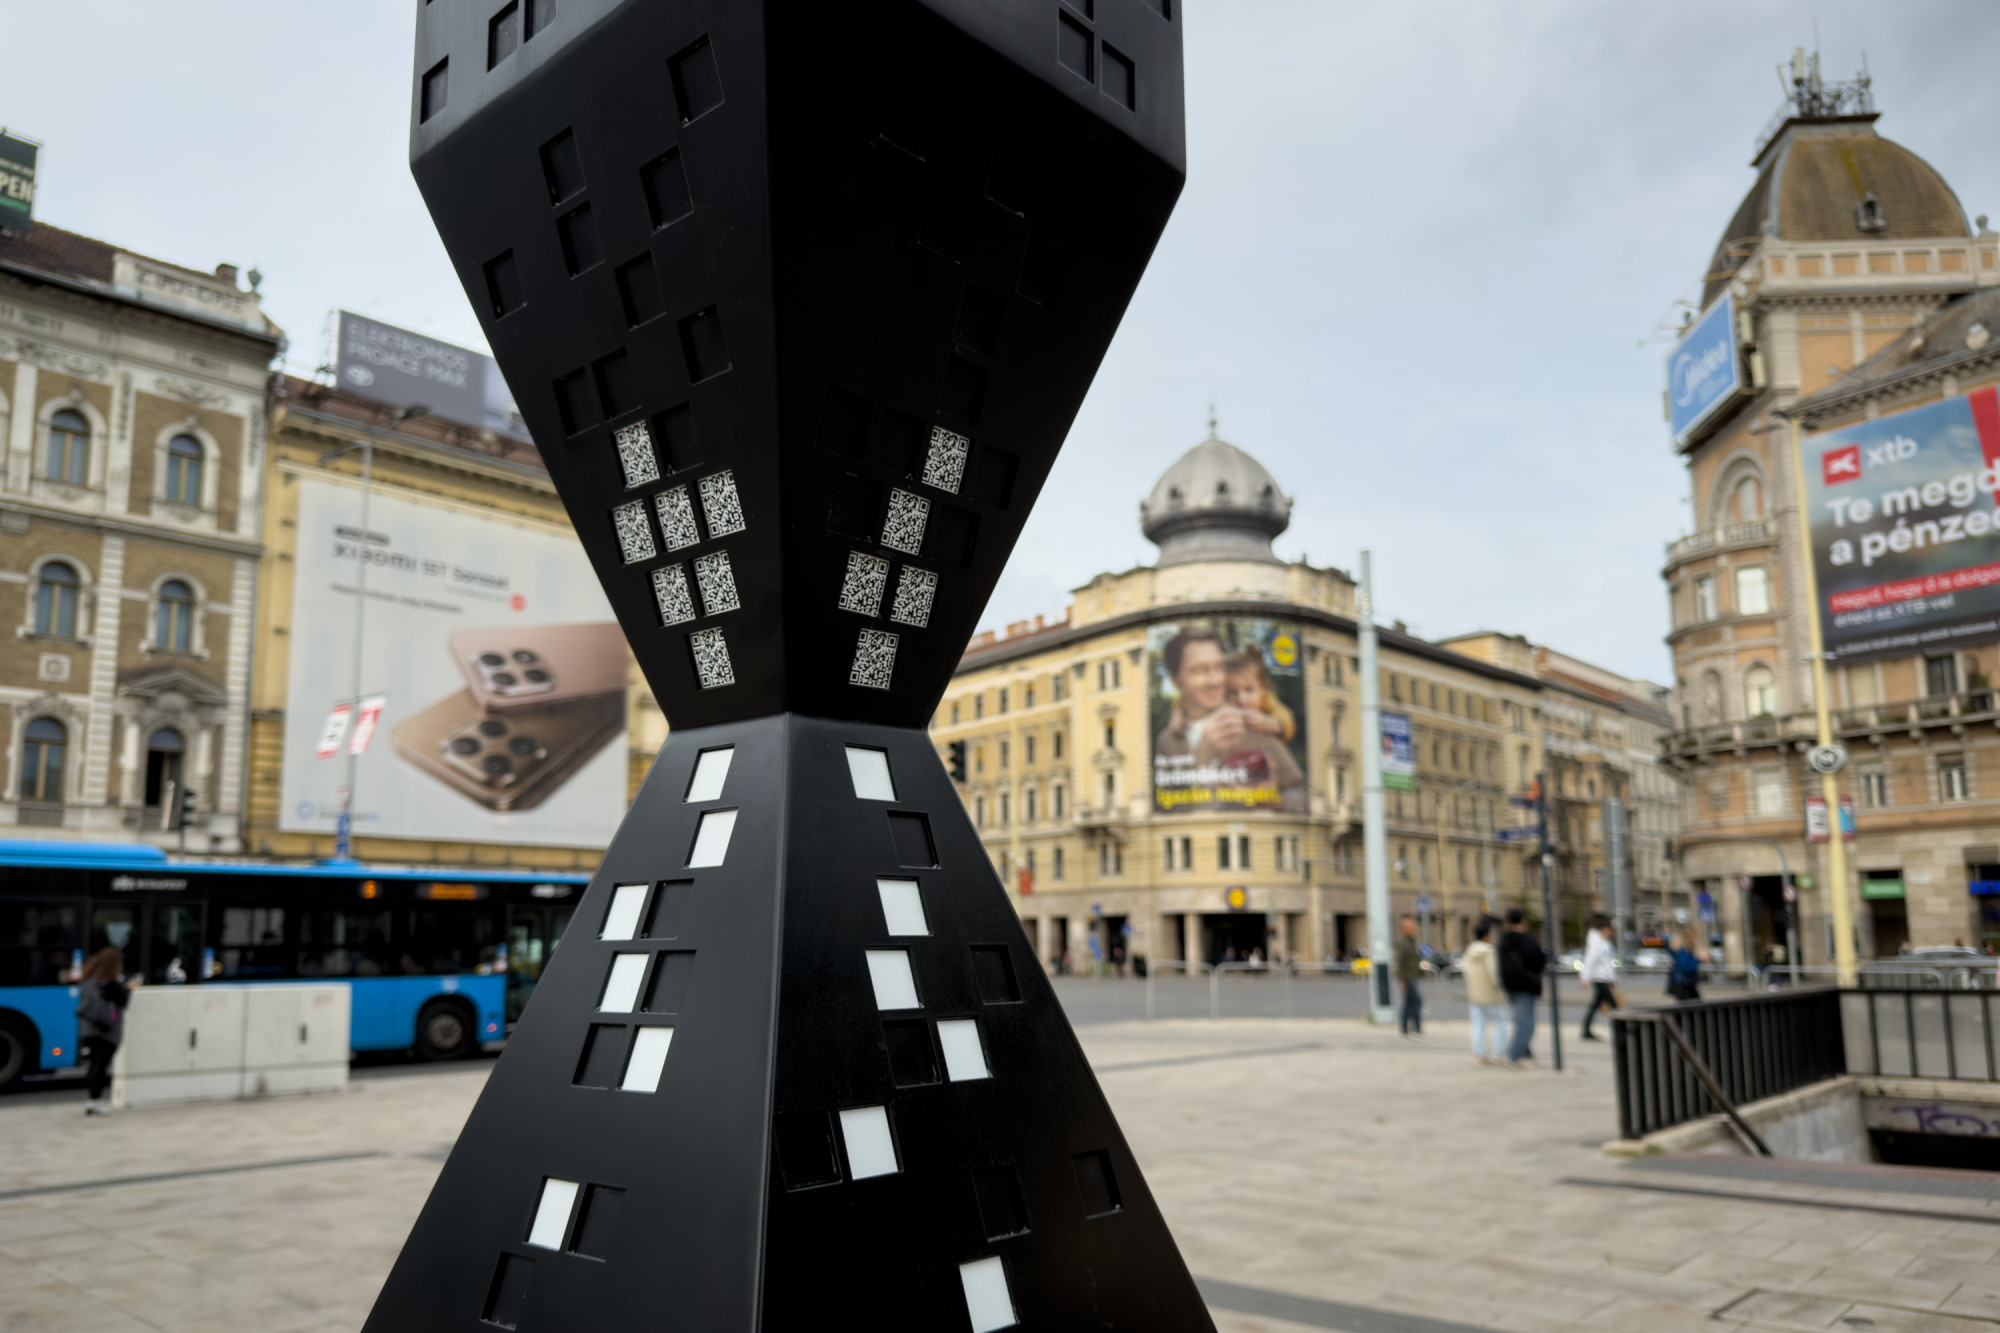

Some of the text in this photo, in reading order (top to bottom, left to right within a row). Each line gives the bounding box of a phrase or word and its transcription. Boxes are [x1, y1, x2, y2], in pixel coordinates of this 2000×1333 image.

[1866, 434, 1918, 468] xtb
[1825, 495, 1874, 528] Te
[1829, 538, 1855, 566] a
